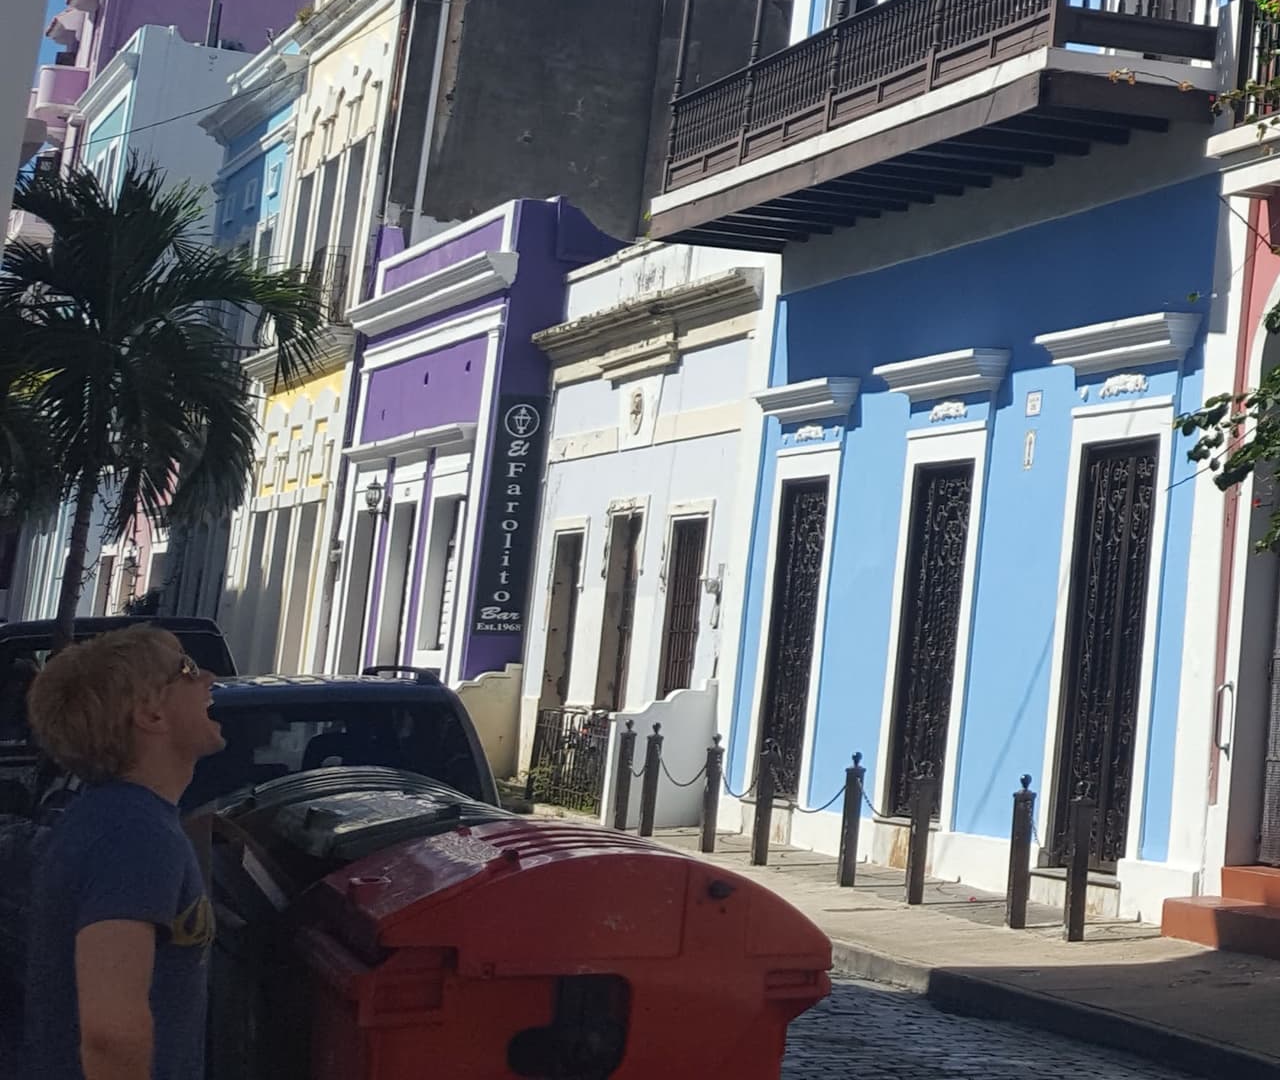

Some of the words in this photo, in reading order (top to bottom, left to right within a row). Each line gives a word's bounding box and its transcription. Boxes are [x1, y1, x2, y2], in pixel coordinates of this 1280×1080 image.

[507, 440, 530, 456] El
[493, 462, 526, 602] Farolito
[480, 606, 520, 620] Bar
